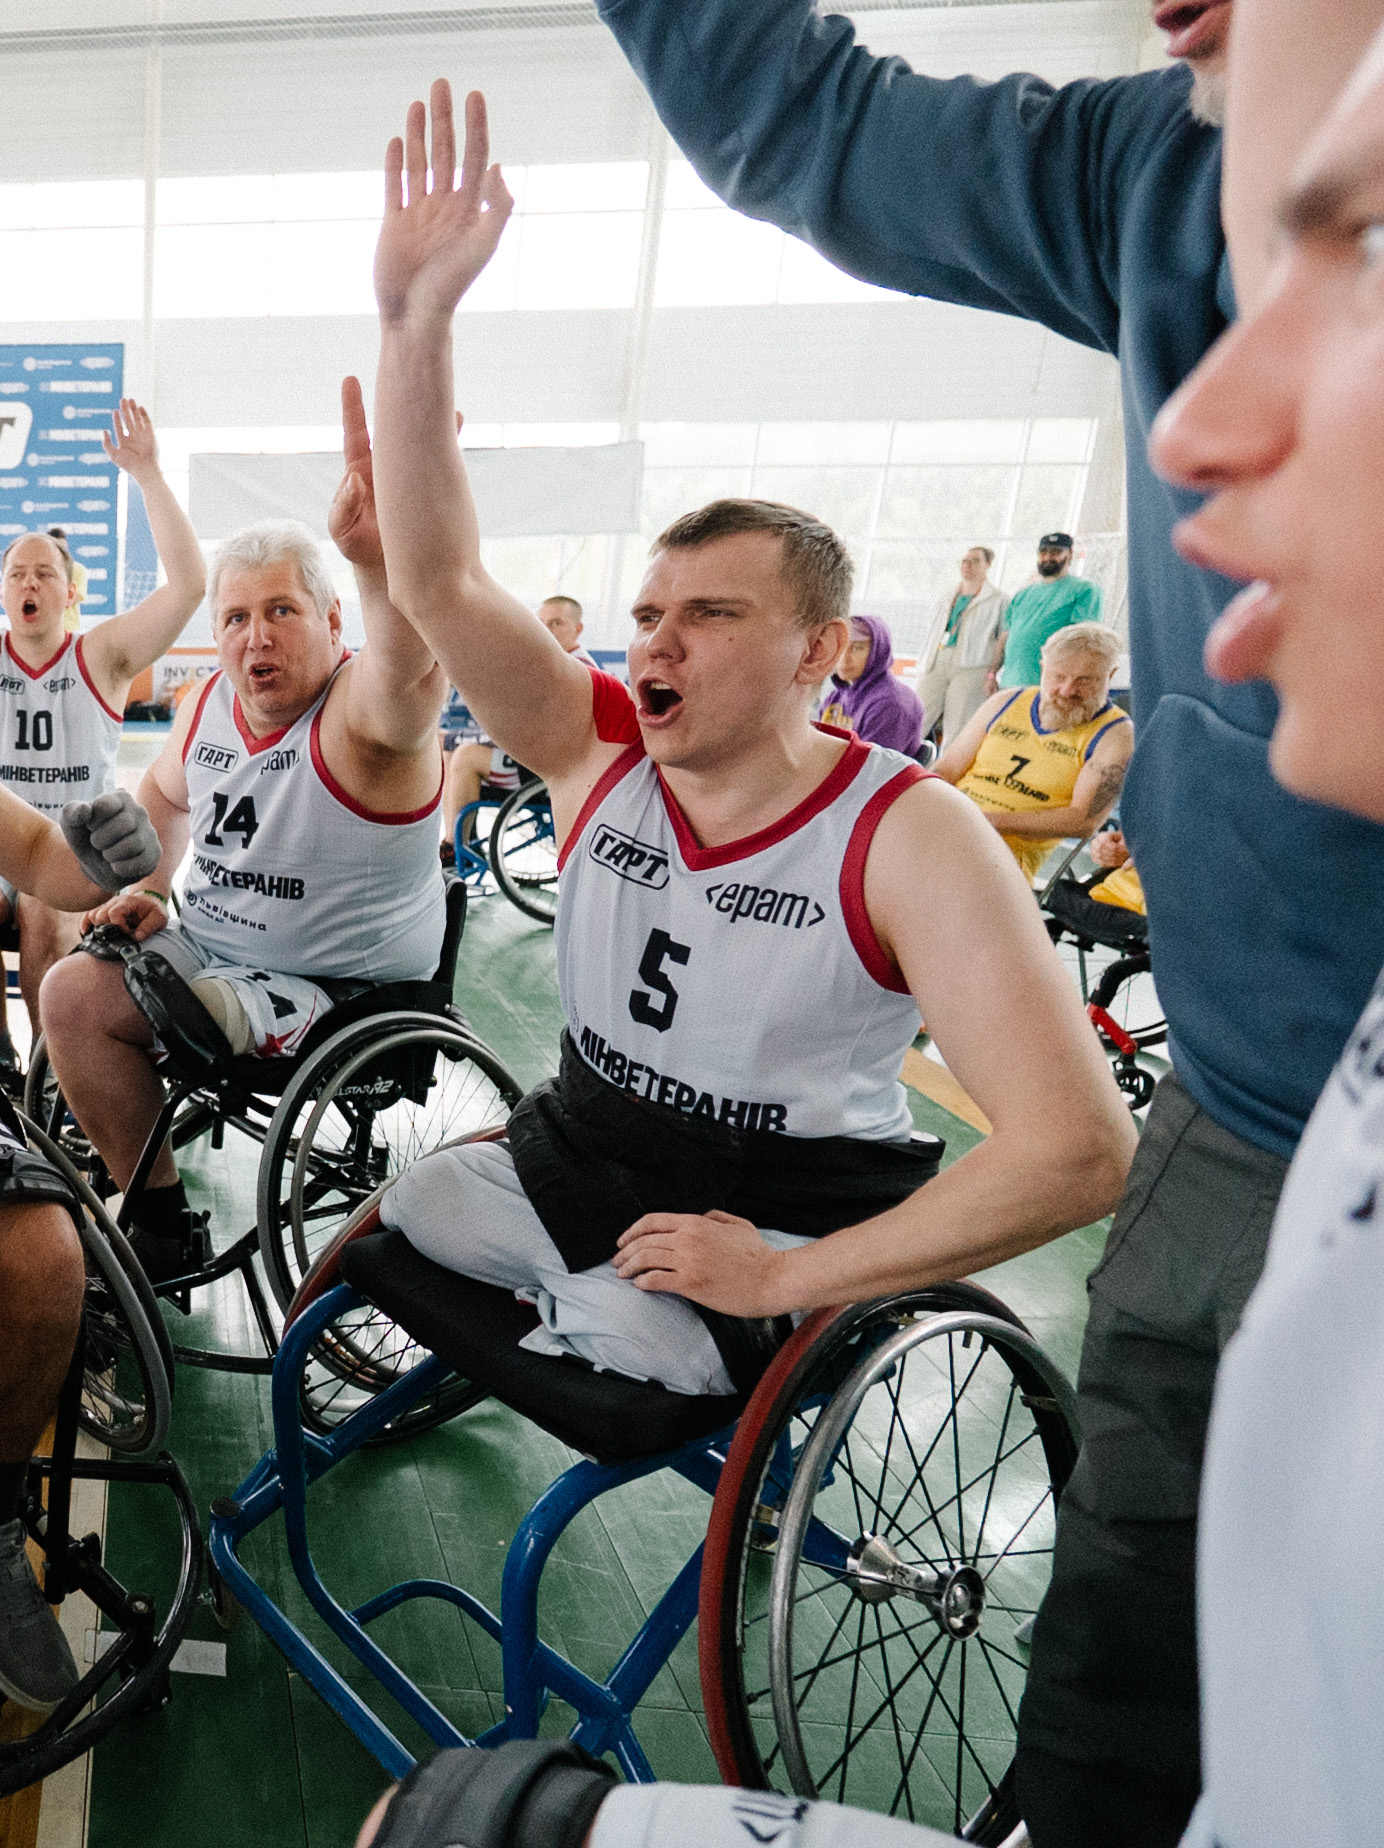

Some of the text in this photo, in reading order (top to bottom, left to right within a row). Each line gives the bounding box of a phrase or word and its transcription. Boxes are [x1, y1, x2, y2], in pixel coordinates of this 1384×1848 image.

[14, 709, 53, 751] 10
[197, 746, 235, 769] ГАРТ
[1009, 755, 1031, 779] 7
[204, 792, 260, 849] 14
[593, 831, 669, 881] ГАРТ
[628, 927, 692, 1034] 5
